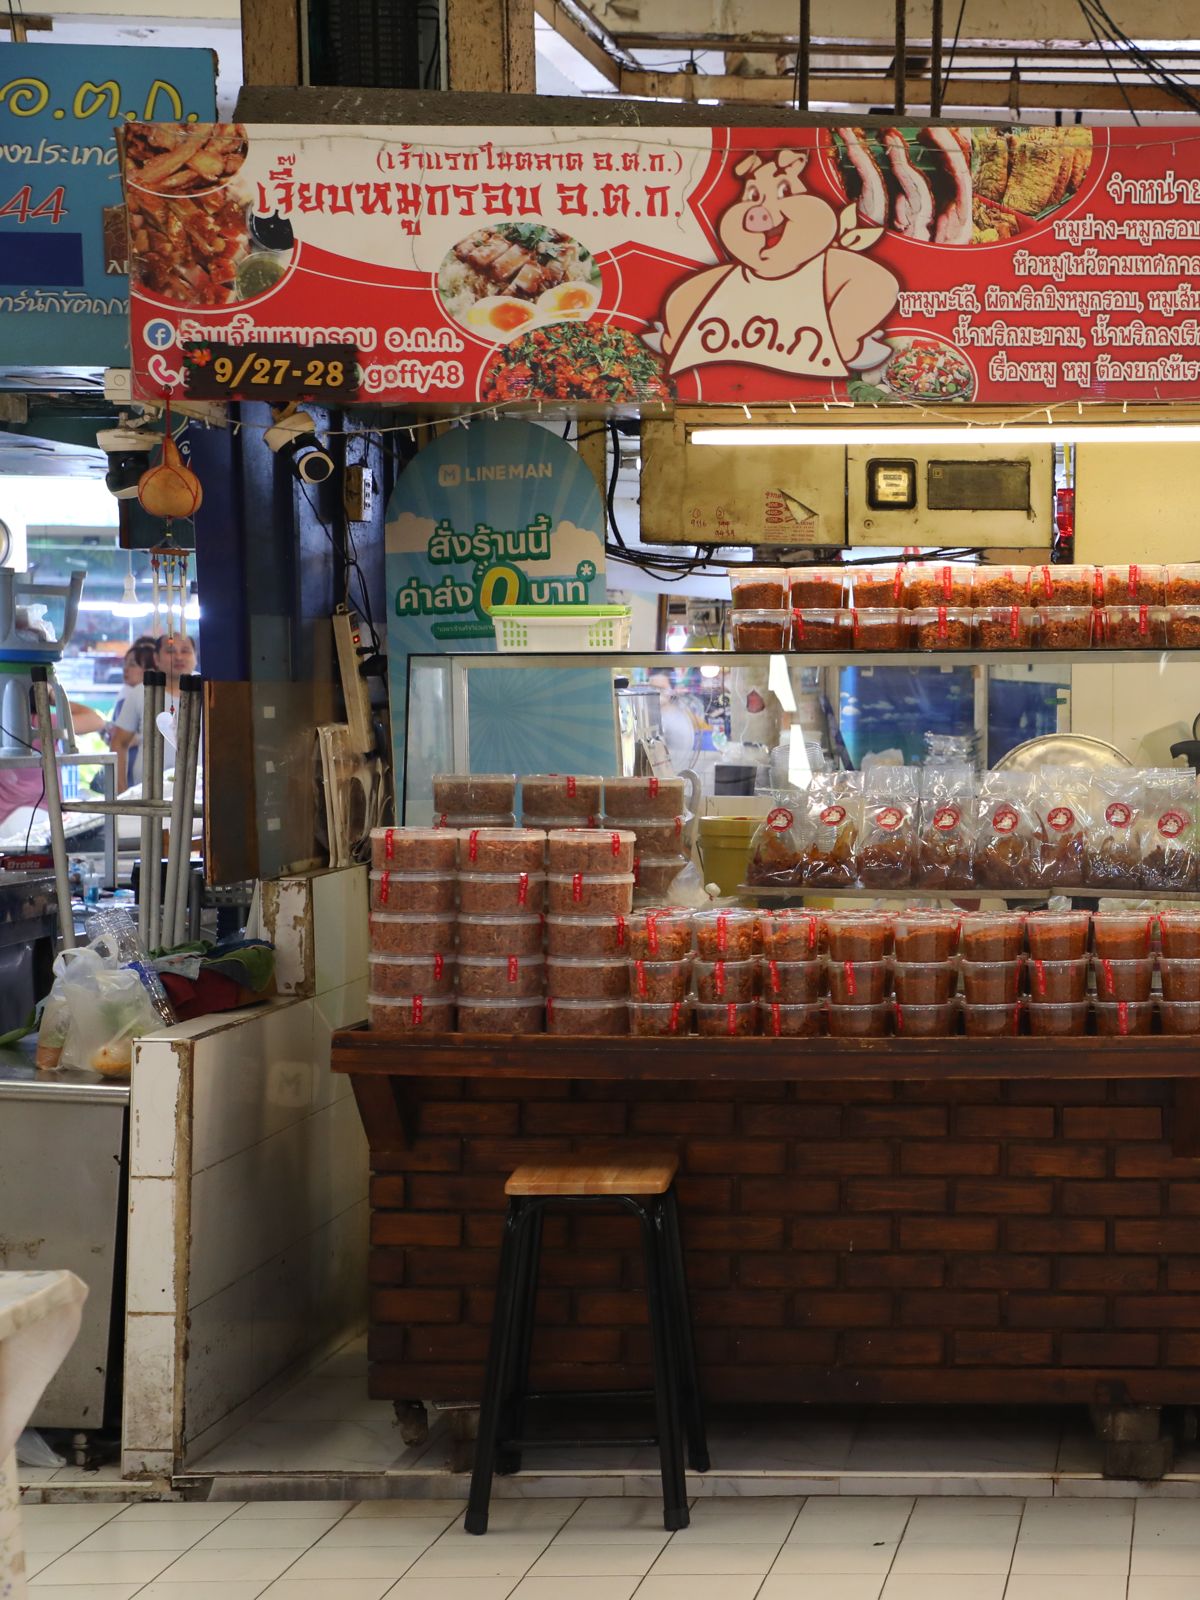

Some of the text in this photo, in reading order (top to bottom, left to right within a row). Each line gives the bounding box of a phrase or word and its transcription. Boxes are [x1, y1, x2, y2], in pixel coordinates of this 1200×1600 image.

[555, 183, 683, 219] อ.ต.ก.
[388, 330, 462, 349] อ.ต.ก.
[698, 315, 831, 367] อ.ต.ก.
[213, 352, 346, 389] 9/27-28
[367, 364, 462, 389] goffy48
[1062, 363, 1091, 389] หมู
[465, 462, 553, 482] LINE MAN
[430, 515, 550, 559] สั่งร้านนี้
[399, 578, 474, 609] ค่าส่ง
